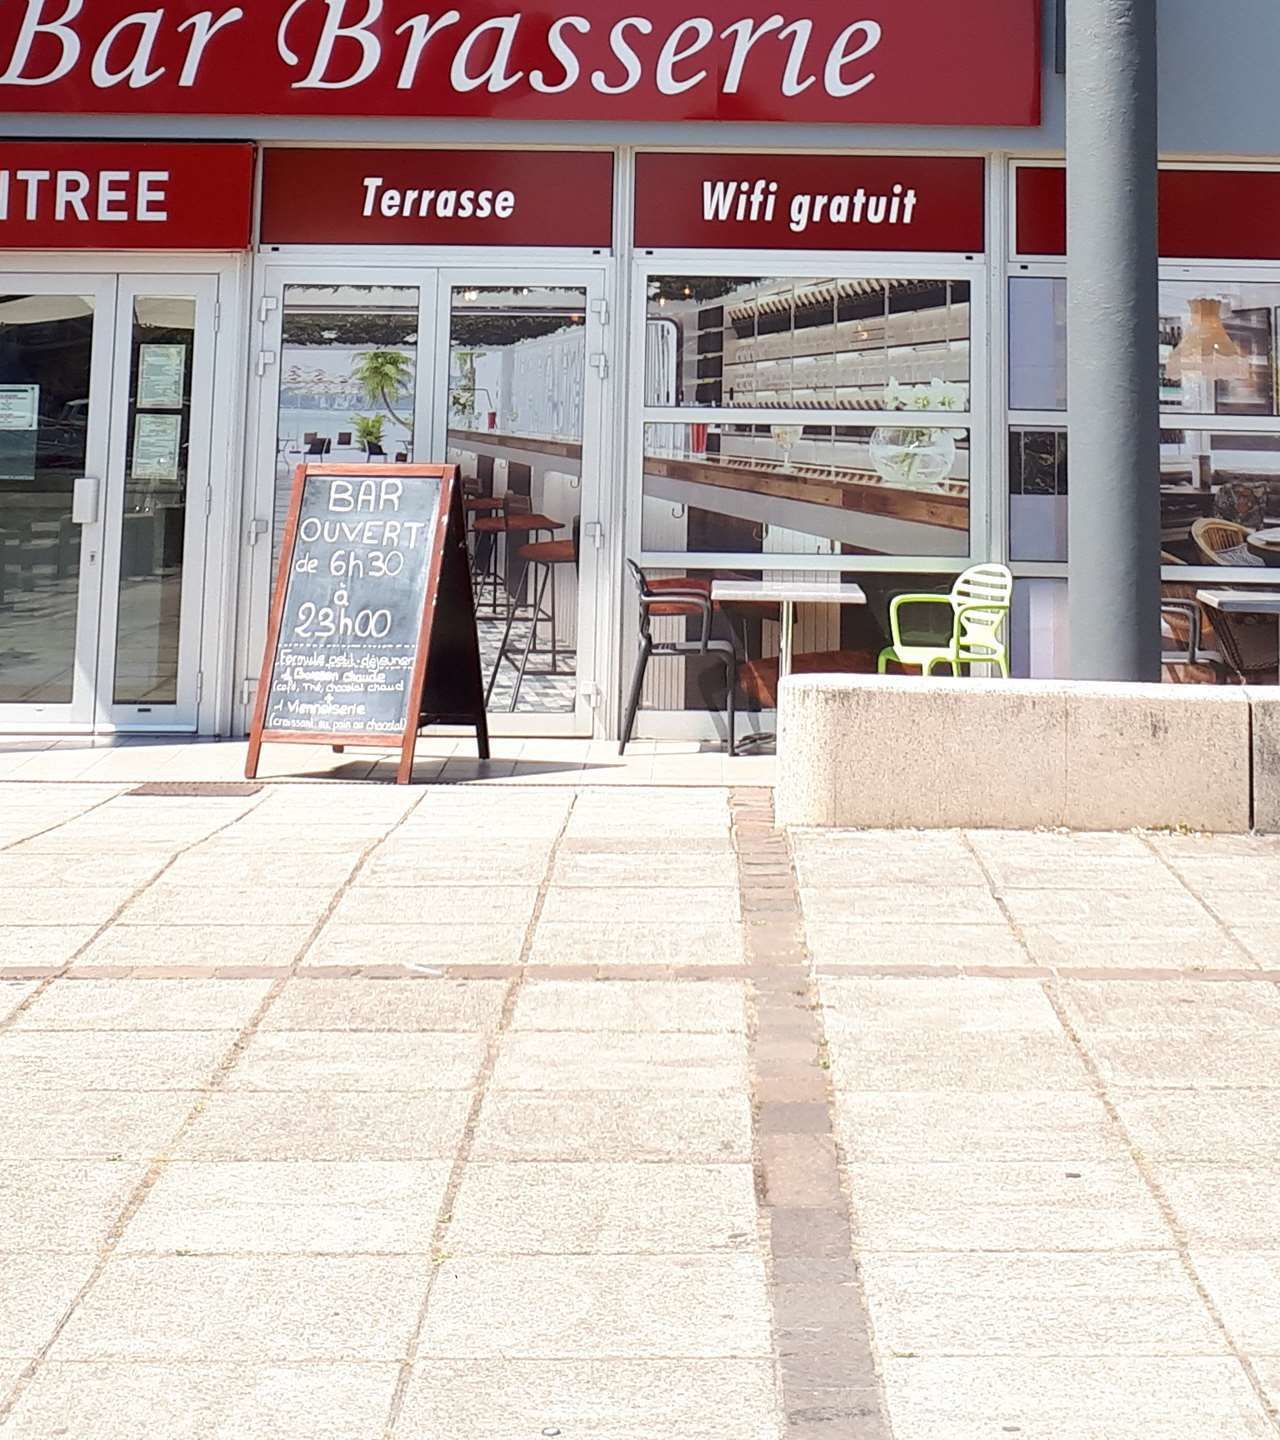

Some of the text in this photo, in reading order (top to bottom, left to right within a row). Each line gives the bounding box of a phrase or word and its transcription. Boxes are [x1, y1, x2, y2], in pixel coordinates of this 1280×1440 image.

[362, 177, 516, 219] Terrasse
[702, 179, 918, 232] Wifi gratuit
[328, 478, 404, 513] BAR
[300, 517, 425, 549] OUVERT
[295, 550, 404, 578] de 6h30
[333, 582, 349, 607] à
[294, 601, 392, 638] 23h00
